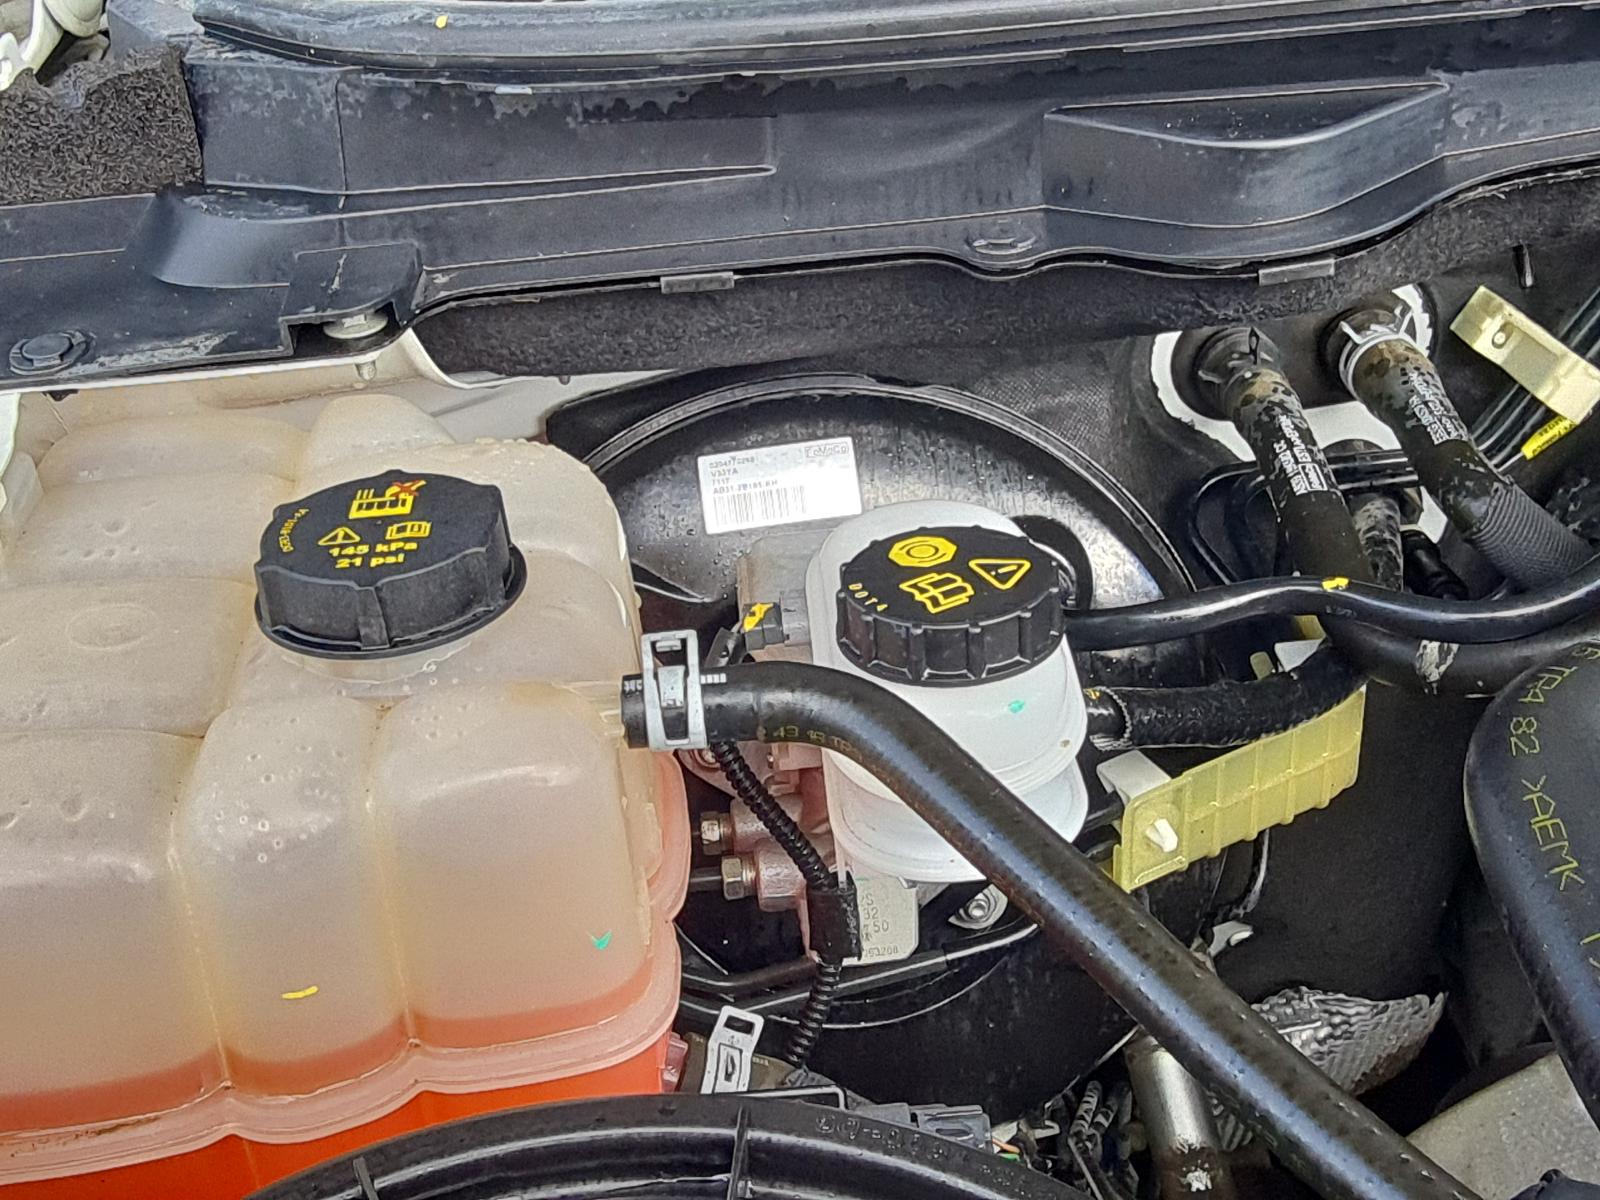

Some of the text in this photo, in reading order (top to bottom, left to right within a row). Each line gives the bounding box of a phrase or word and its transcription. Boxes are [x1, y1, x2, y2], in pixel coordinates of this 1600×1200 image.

[329, 541, 419, 557] 145 kPa
[334, 553, 405, 569] 21 psi
[1509, 716, 1541, 757] 82
